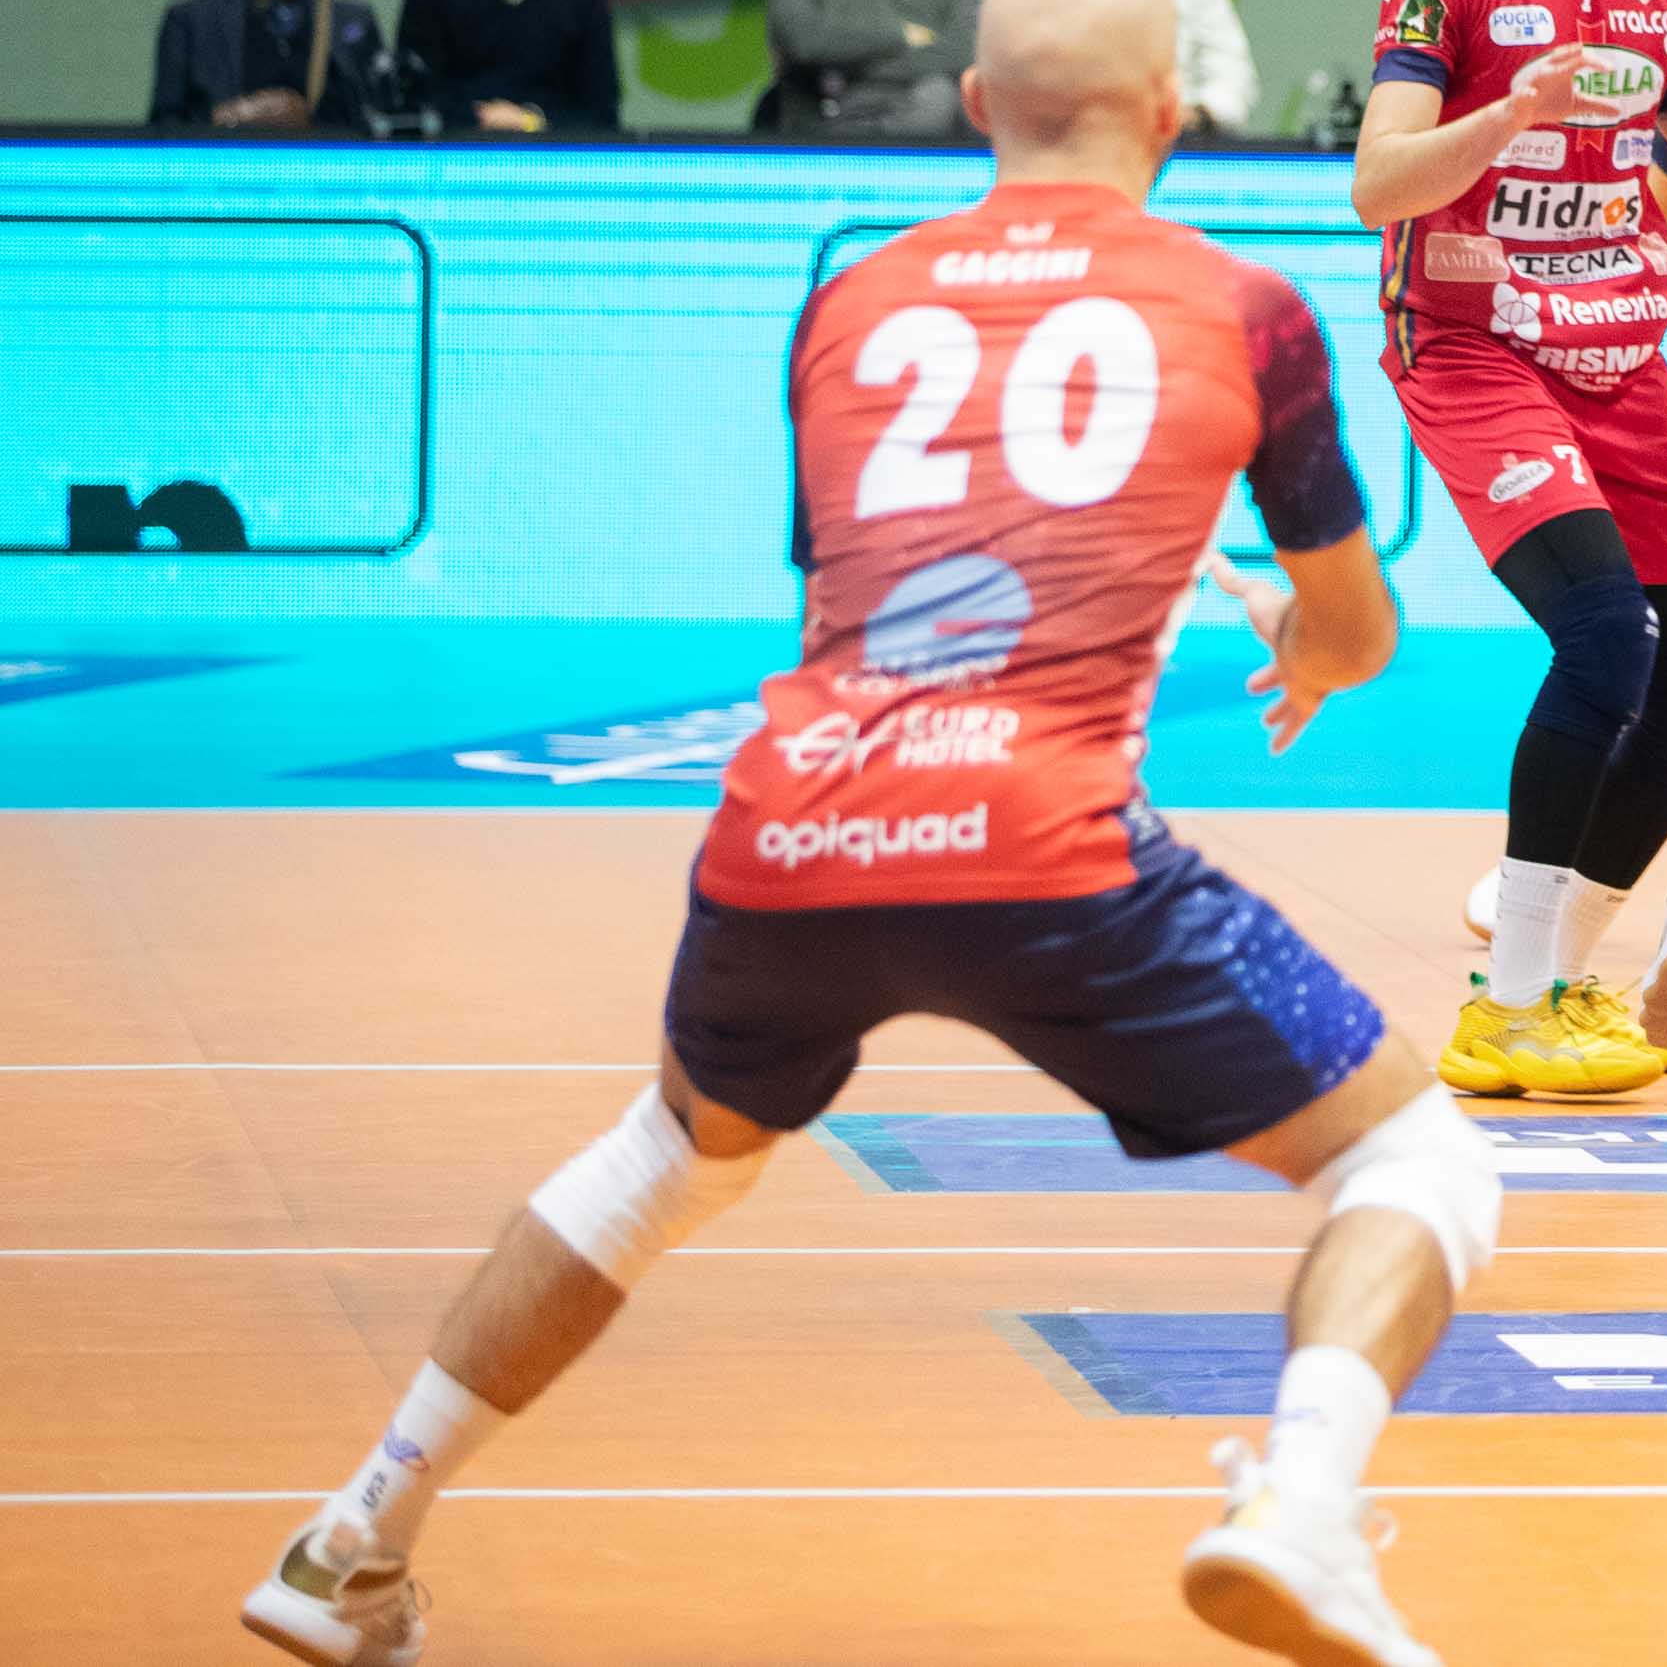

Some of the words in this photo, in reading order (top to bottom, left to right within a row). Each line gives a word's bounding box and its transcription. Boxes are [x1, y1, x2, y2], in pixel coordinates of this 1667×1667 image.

[1493, 11, 1548, 26] PUGLIA
[1492, 184, 1640, 230] Hidros
[930, 247, 1093, 287] GAGGINI
[1515, 248, 1633, 276] TECNA
[853, 295, 1160, 520] 20
[1552, 444, 1588, 485] 7
[901, 704, 1020, 737] EURO
[895, 734, 1014, 768] HOTEL
[754, 801, 989, 871] opiquad
